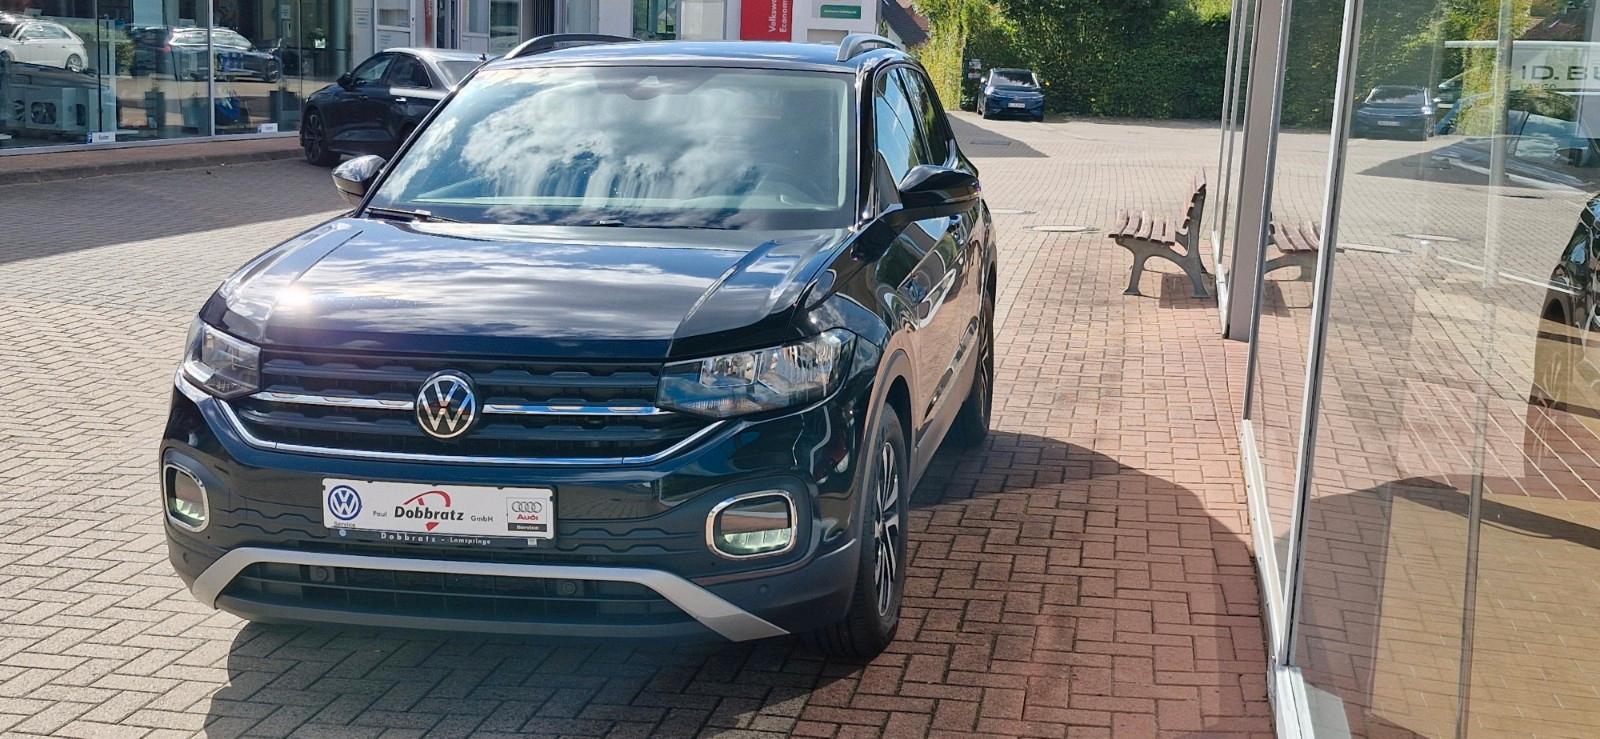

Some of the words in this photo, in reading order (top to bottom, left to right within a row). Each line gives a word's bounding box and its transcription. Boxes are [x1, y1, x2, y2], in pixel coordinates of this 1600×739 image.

[416, 374, 476, 438] VW
[328, 485, 362, 520] VW
[372, 510, 387, 518] Paul
[394, 505, 465, 520] Dobbratz
[470, 514, 494, 523] GmbH
[517, 513, 539, 521] Audi
[380, 532, 436, 543] Dobbratz
